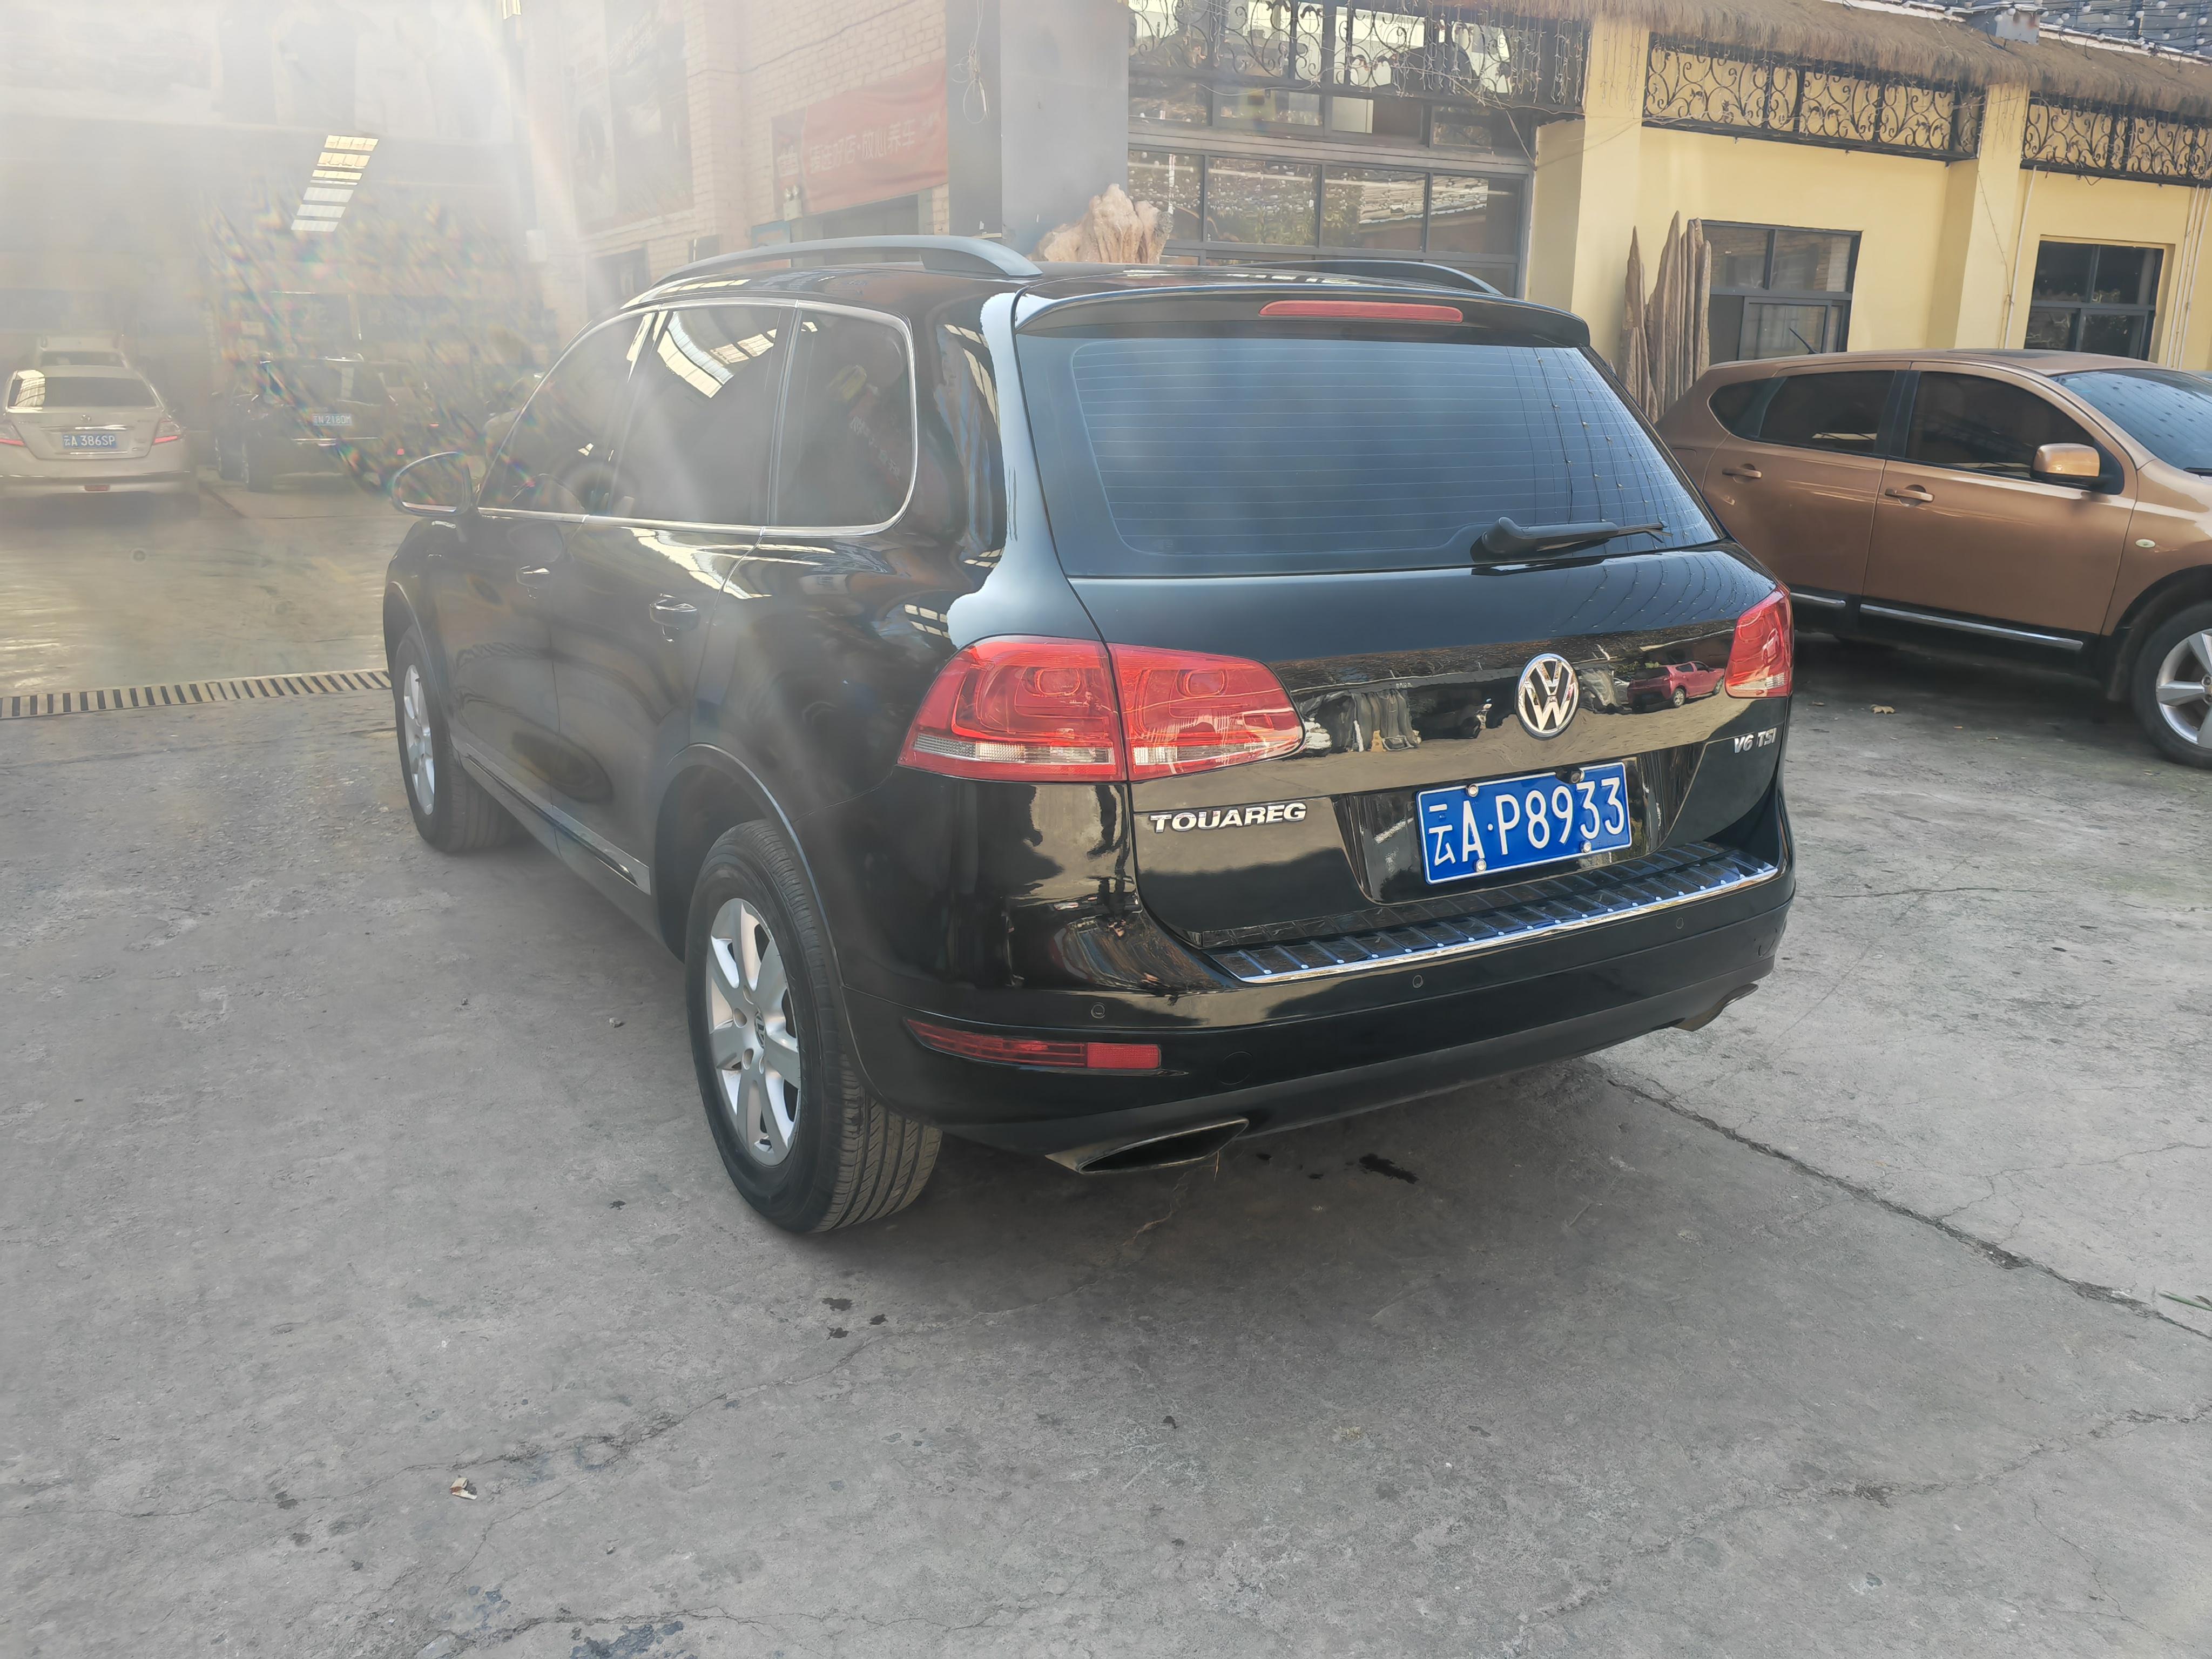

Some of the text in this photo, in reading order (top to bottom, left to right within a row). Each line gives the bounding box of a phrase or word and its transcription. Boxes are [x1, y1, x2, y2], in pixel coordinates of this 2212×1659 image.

[1734, 727, 1777, 753] V6 TSI
[1150, 802, 1307, 833] TOUAREG
